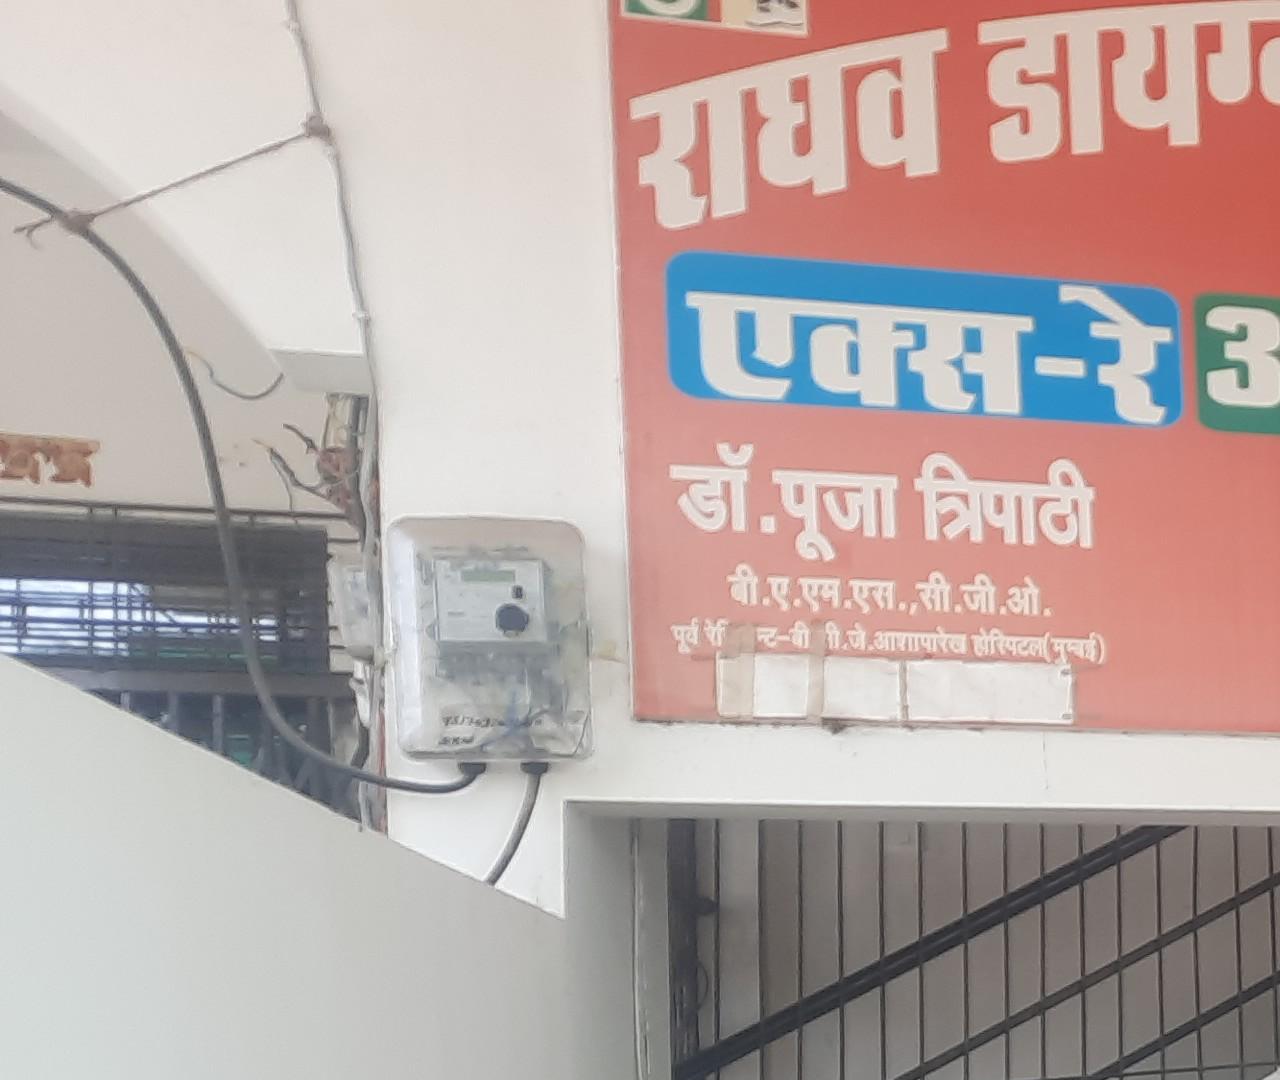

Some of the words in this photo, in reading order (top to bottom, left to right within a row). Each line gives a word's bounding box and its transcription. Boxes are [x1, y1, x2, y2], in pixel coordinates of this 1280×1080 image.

[629, 27, 950, 231] राघव
[684, 284, 1174, 424] एक्स-रे
[913, 452, 1097, 550] त्रिपाठी
